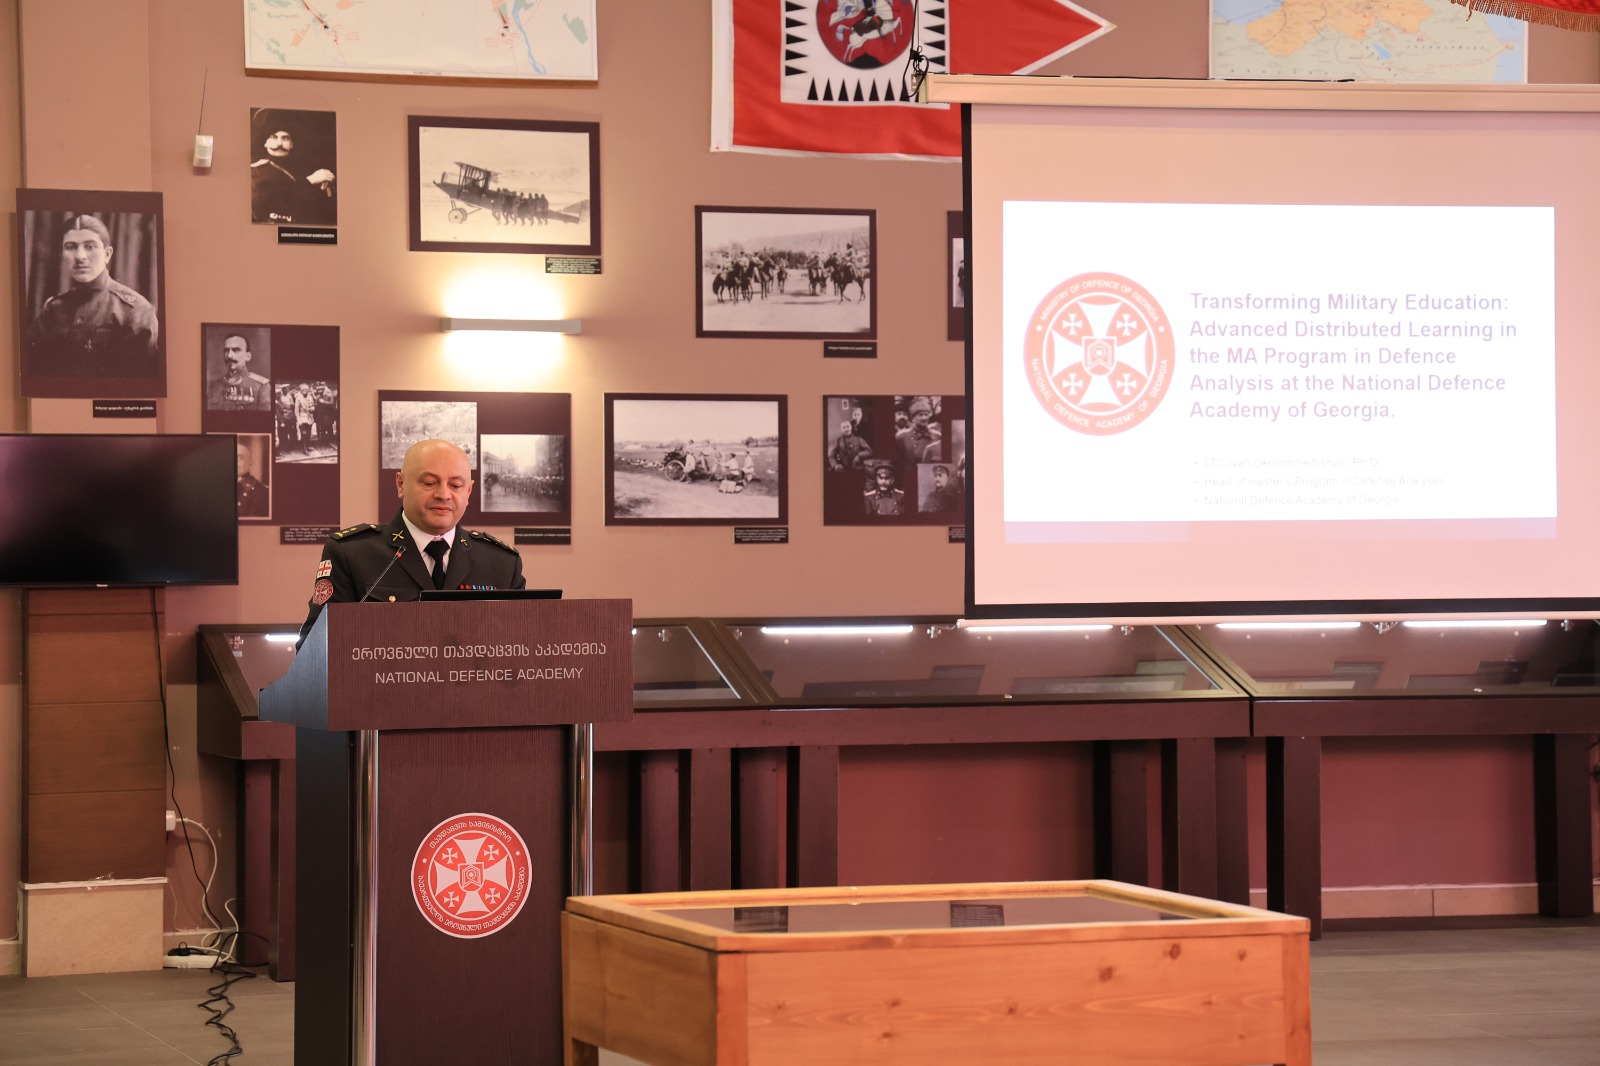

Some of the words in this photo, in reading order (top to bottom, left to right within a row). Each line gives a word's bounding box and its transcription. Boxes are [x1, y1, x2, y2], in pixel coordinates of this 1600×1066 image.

[1082, 279, 1119, 290] DEFENCE
[1190, 292, 1320, 314] Transforming
[1328, 293, 1398, 314] Military
[1405, 293, 1509, 310] Education:
[1189, 320, 1288, 337] Advanced
[1295, 320, 1402, 337] Distributed
[1409, 321, 1493, 342] Learning
[1500, 321, 1517, 337] in
[1190, 347, 1220, 364] the
[1227, 347, 1258, 364] MA
[1265, 347, 1347, 369] Program
[1354, 348, 1371, 364] in
[1378, 348, 1456, 364] Defence
[1190, 374, 1274, 395] Analysis
[1281, 375, 1299, 391] at
[1305, 374, 1335, 391] the
[1342, 374, 1421, 391] National
[1428, 374, 1506, 391] Defence
[1190, 401, 1281, 422] Academy
[1288, 401, 1307, 418] of
[1313, 401, 1395, 422] Georgia.
[1204, 477, 1232, 487] Head
[351, 646, 438, 661] ეროვნული
[443, 643, 530, 659] თავდაცვის
[535, 642, 607, 656] აკადემია
[375, 671, 445, 684] NATIONAL
[449, 669, 513, 683] DEFENCE
[516, 667, 584, 680] ACADEMY
